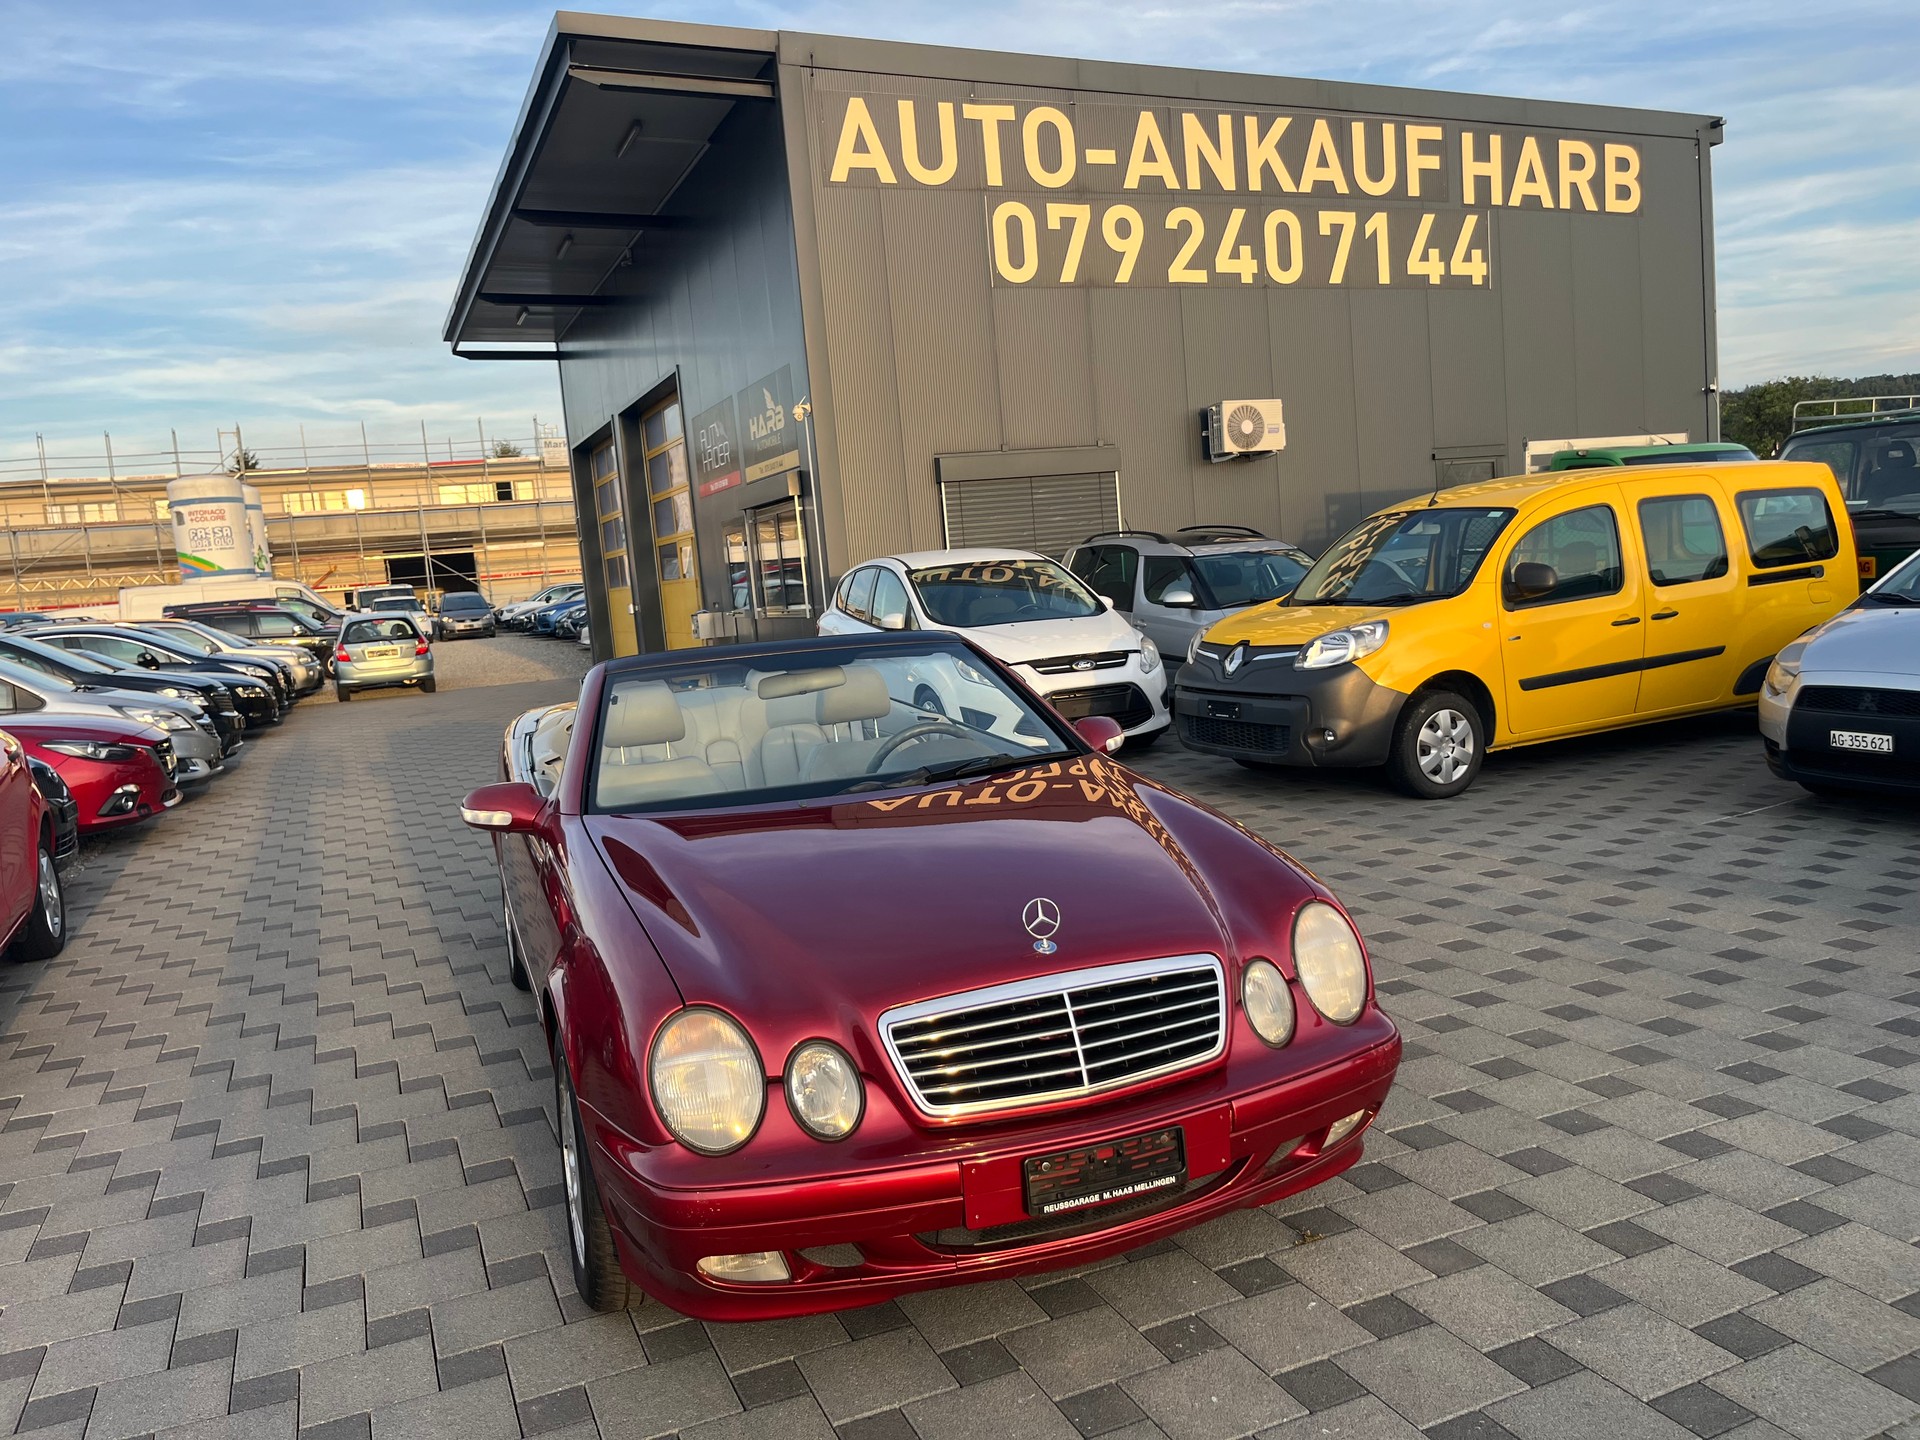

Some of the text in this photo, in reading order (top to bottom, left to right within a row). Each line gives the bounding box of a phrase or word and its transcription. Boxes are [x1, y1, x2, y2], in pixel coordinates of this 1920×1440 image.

[830, 98, 1640, 212] AUTO-ANKAUF HARB
[993, 202, 1486, 284] 079 240 71 44
[749, 404, 785, 440] HARB
[190, 537, 234, 548] BOROLO
[1043, 1193, 1100, 1213] REUSSGARAGE
[1112, 1185, 1134, 1197] HAAS
[1133, 1175, 1176, 1192] MELLINGEN
